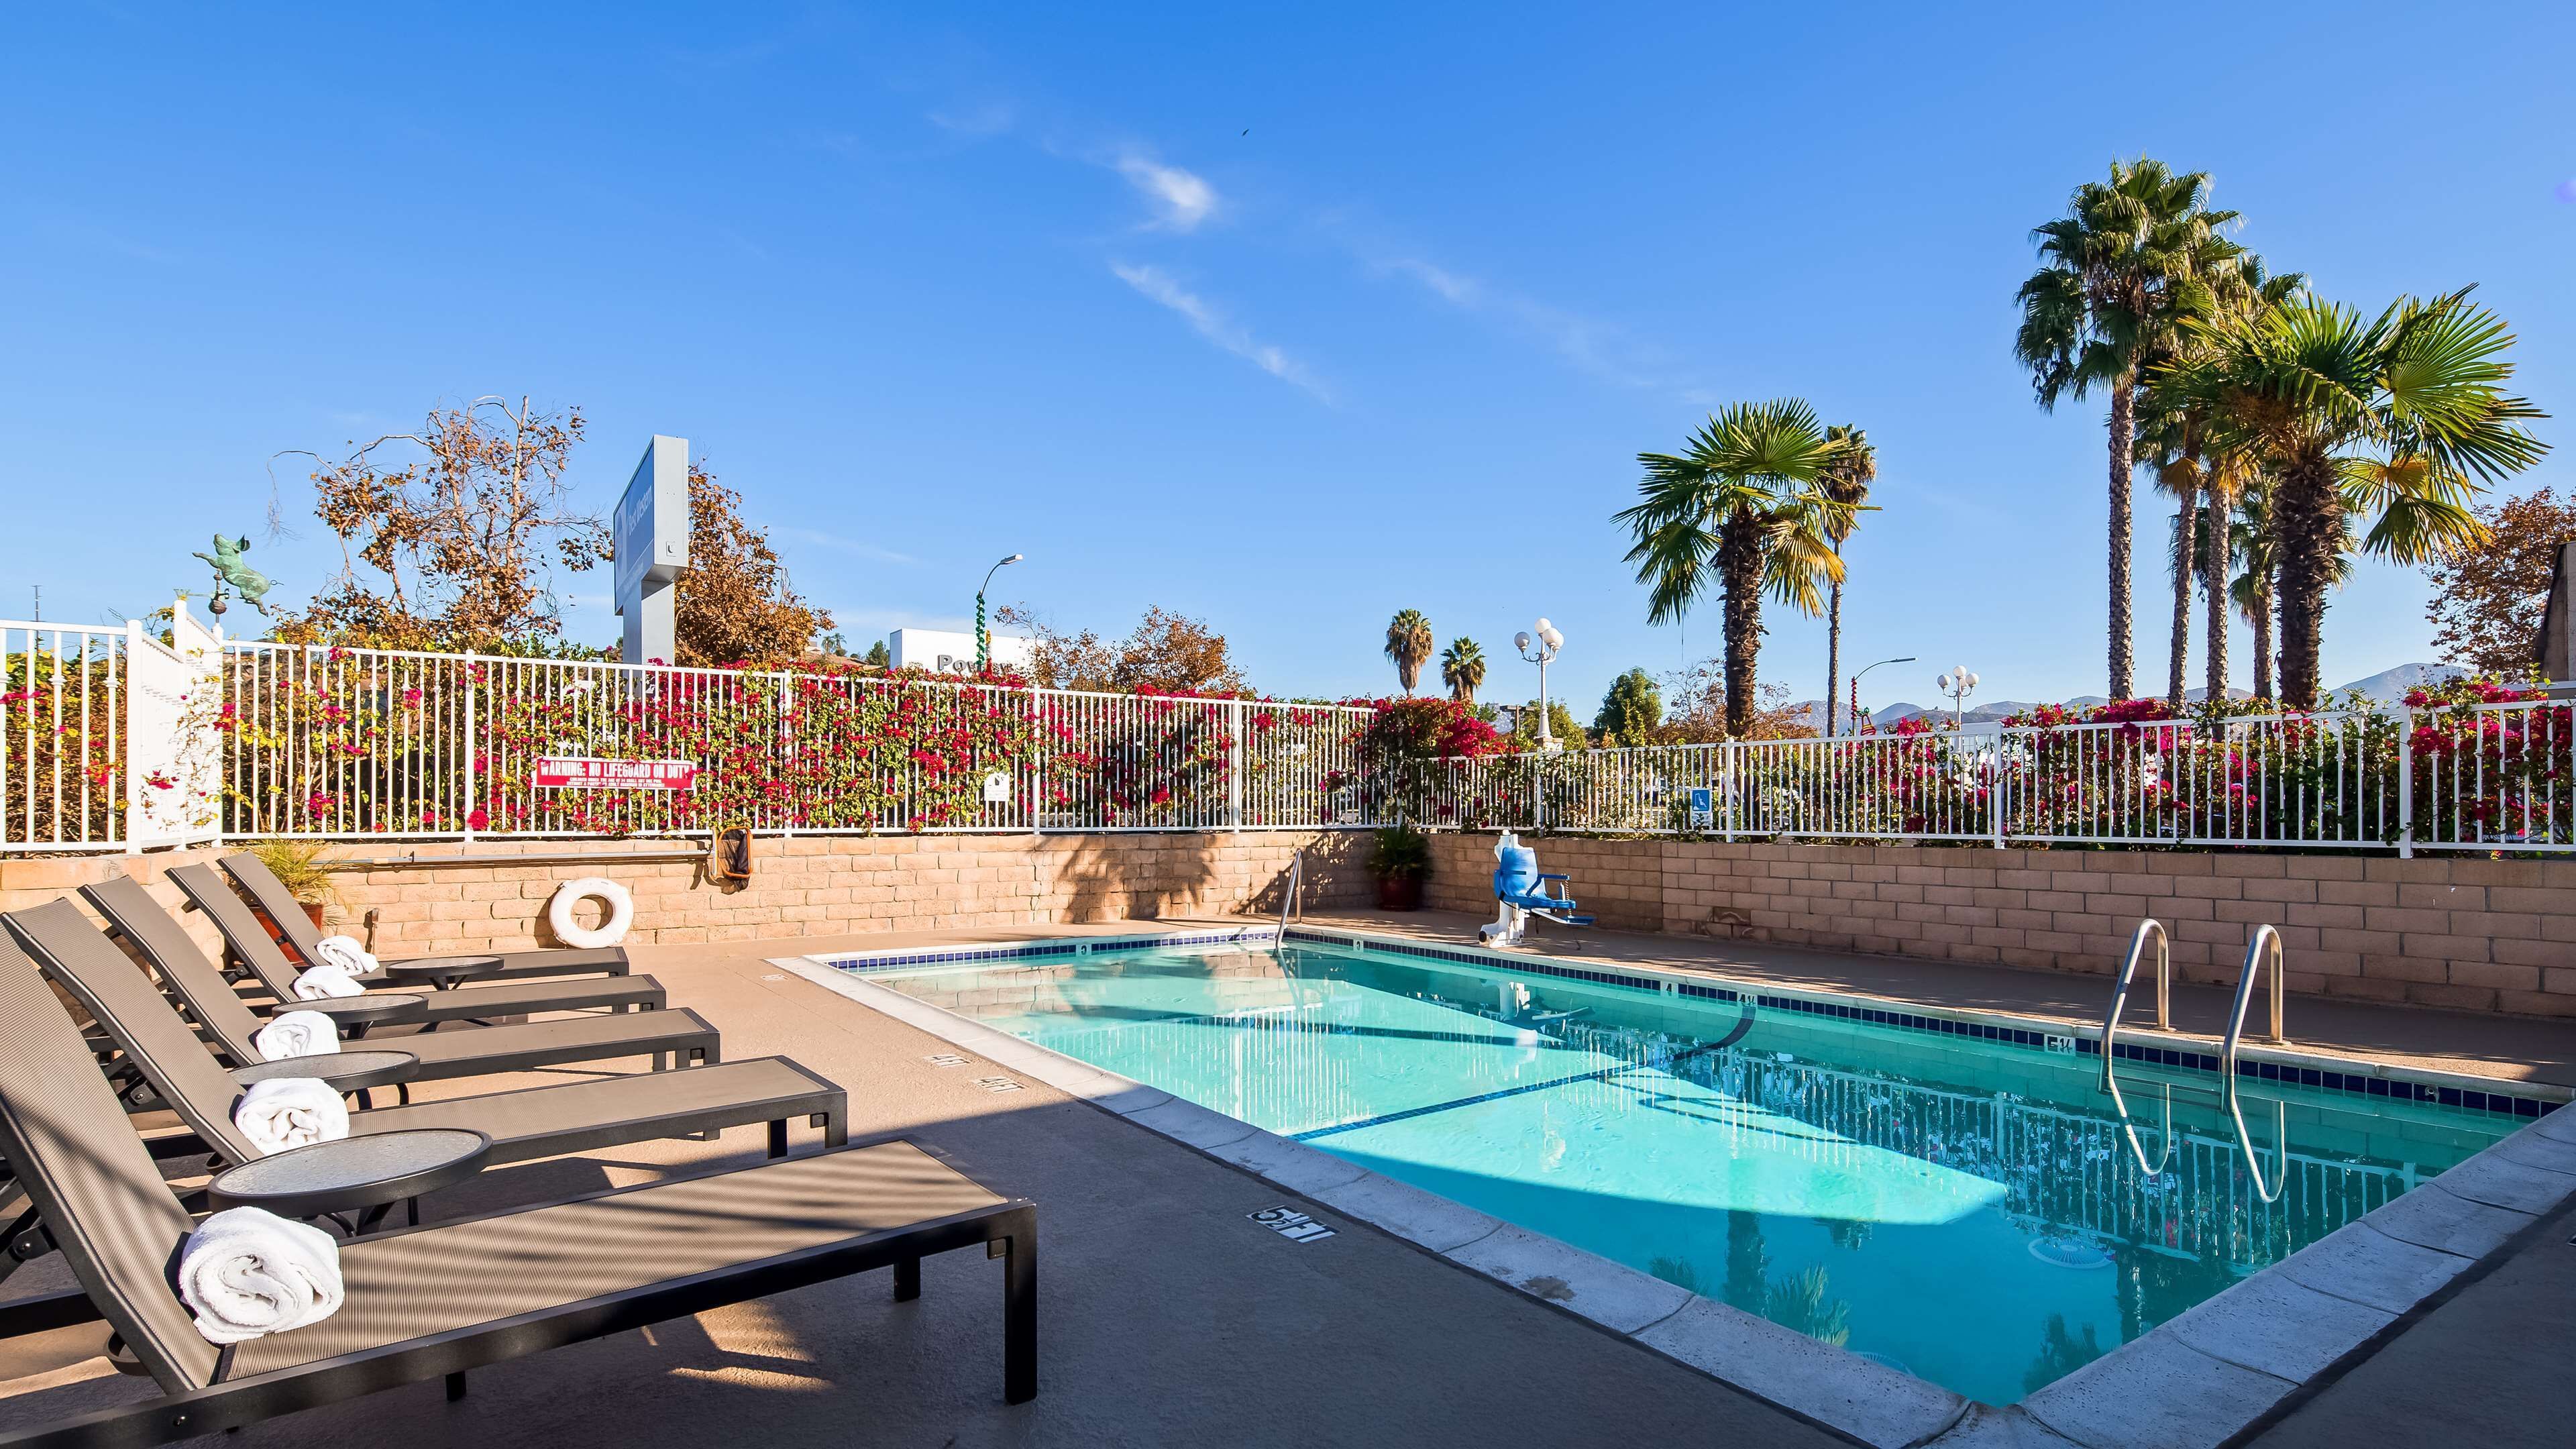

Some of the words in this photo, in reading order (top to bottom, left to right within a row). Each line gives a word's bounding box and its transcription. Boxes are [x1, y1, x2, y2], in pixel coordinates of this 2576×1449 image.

[540, 761, 586, 776] WARNING:
[588, 762, 601, 777] NO
[604, 762, 651, 778] LIFEGUARD
[653, 764, 665, 778] ON
[667, 765, 690, 779] DUTY
[1276, 1218, 1340, 1240] FT
